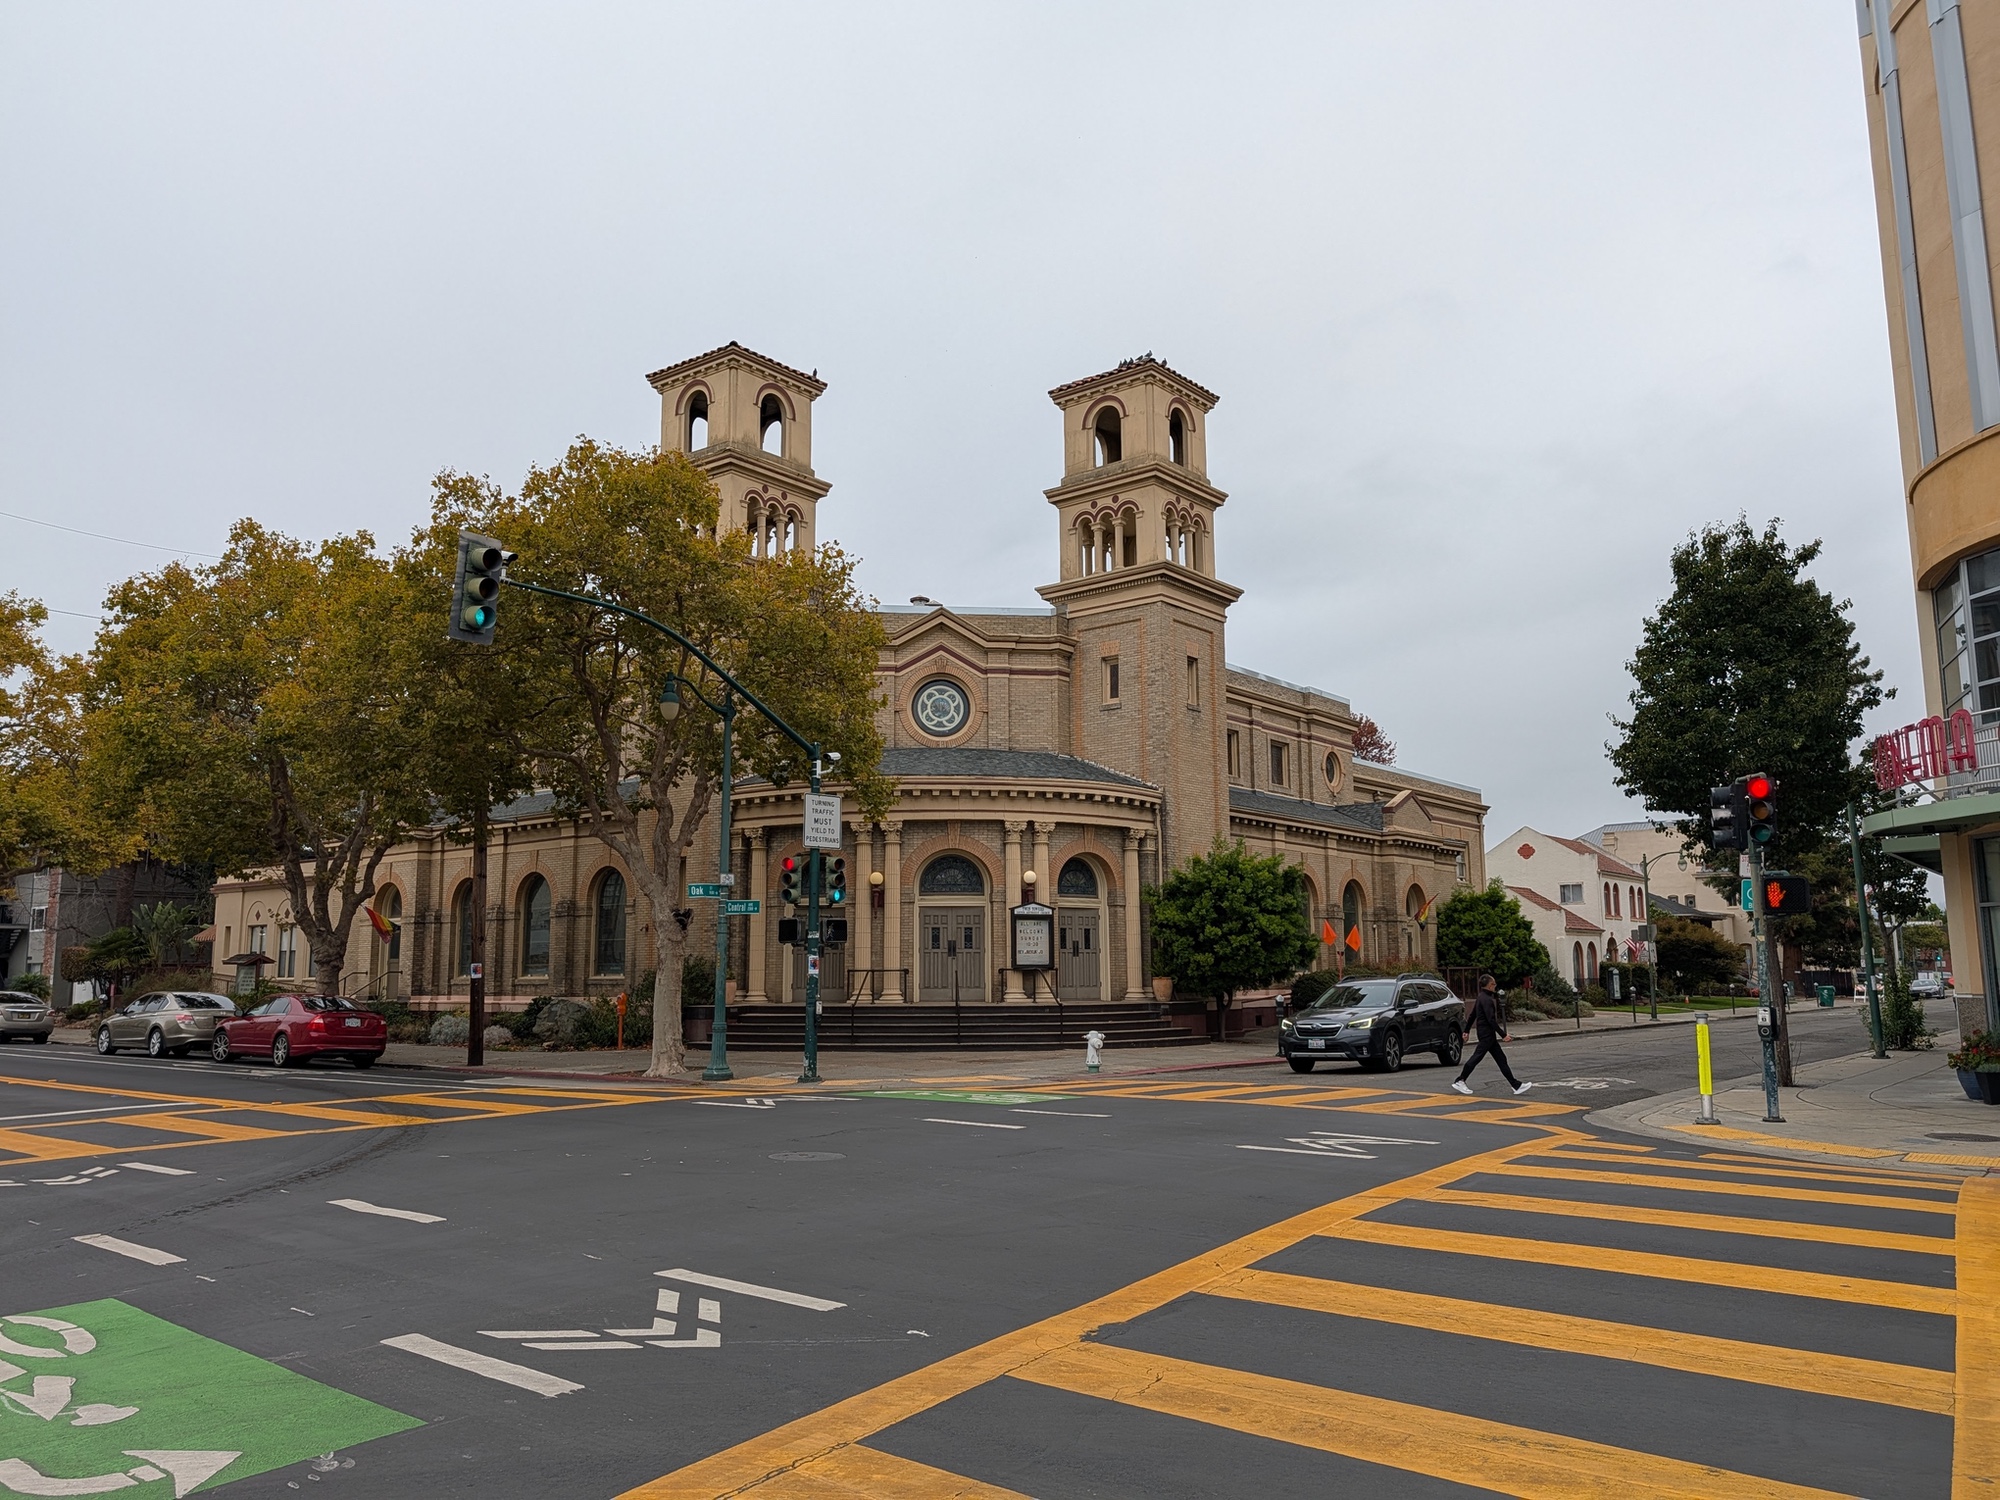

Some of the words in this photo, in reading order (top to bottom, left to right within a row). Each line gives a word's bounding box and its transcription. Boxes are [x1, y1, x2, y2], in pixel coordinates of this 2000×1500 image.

[811, 799, 835, 807] TURNING
[811, 808, 834, 816] TRAFFIC
[813, 817, 832, 826] MUST
[805, 835, 839, 844] PEDESTRIANS
[691, 886, 704, 895] Oak
[728, 902, 746, 912] Central
